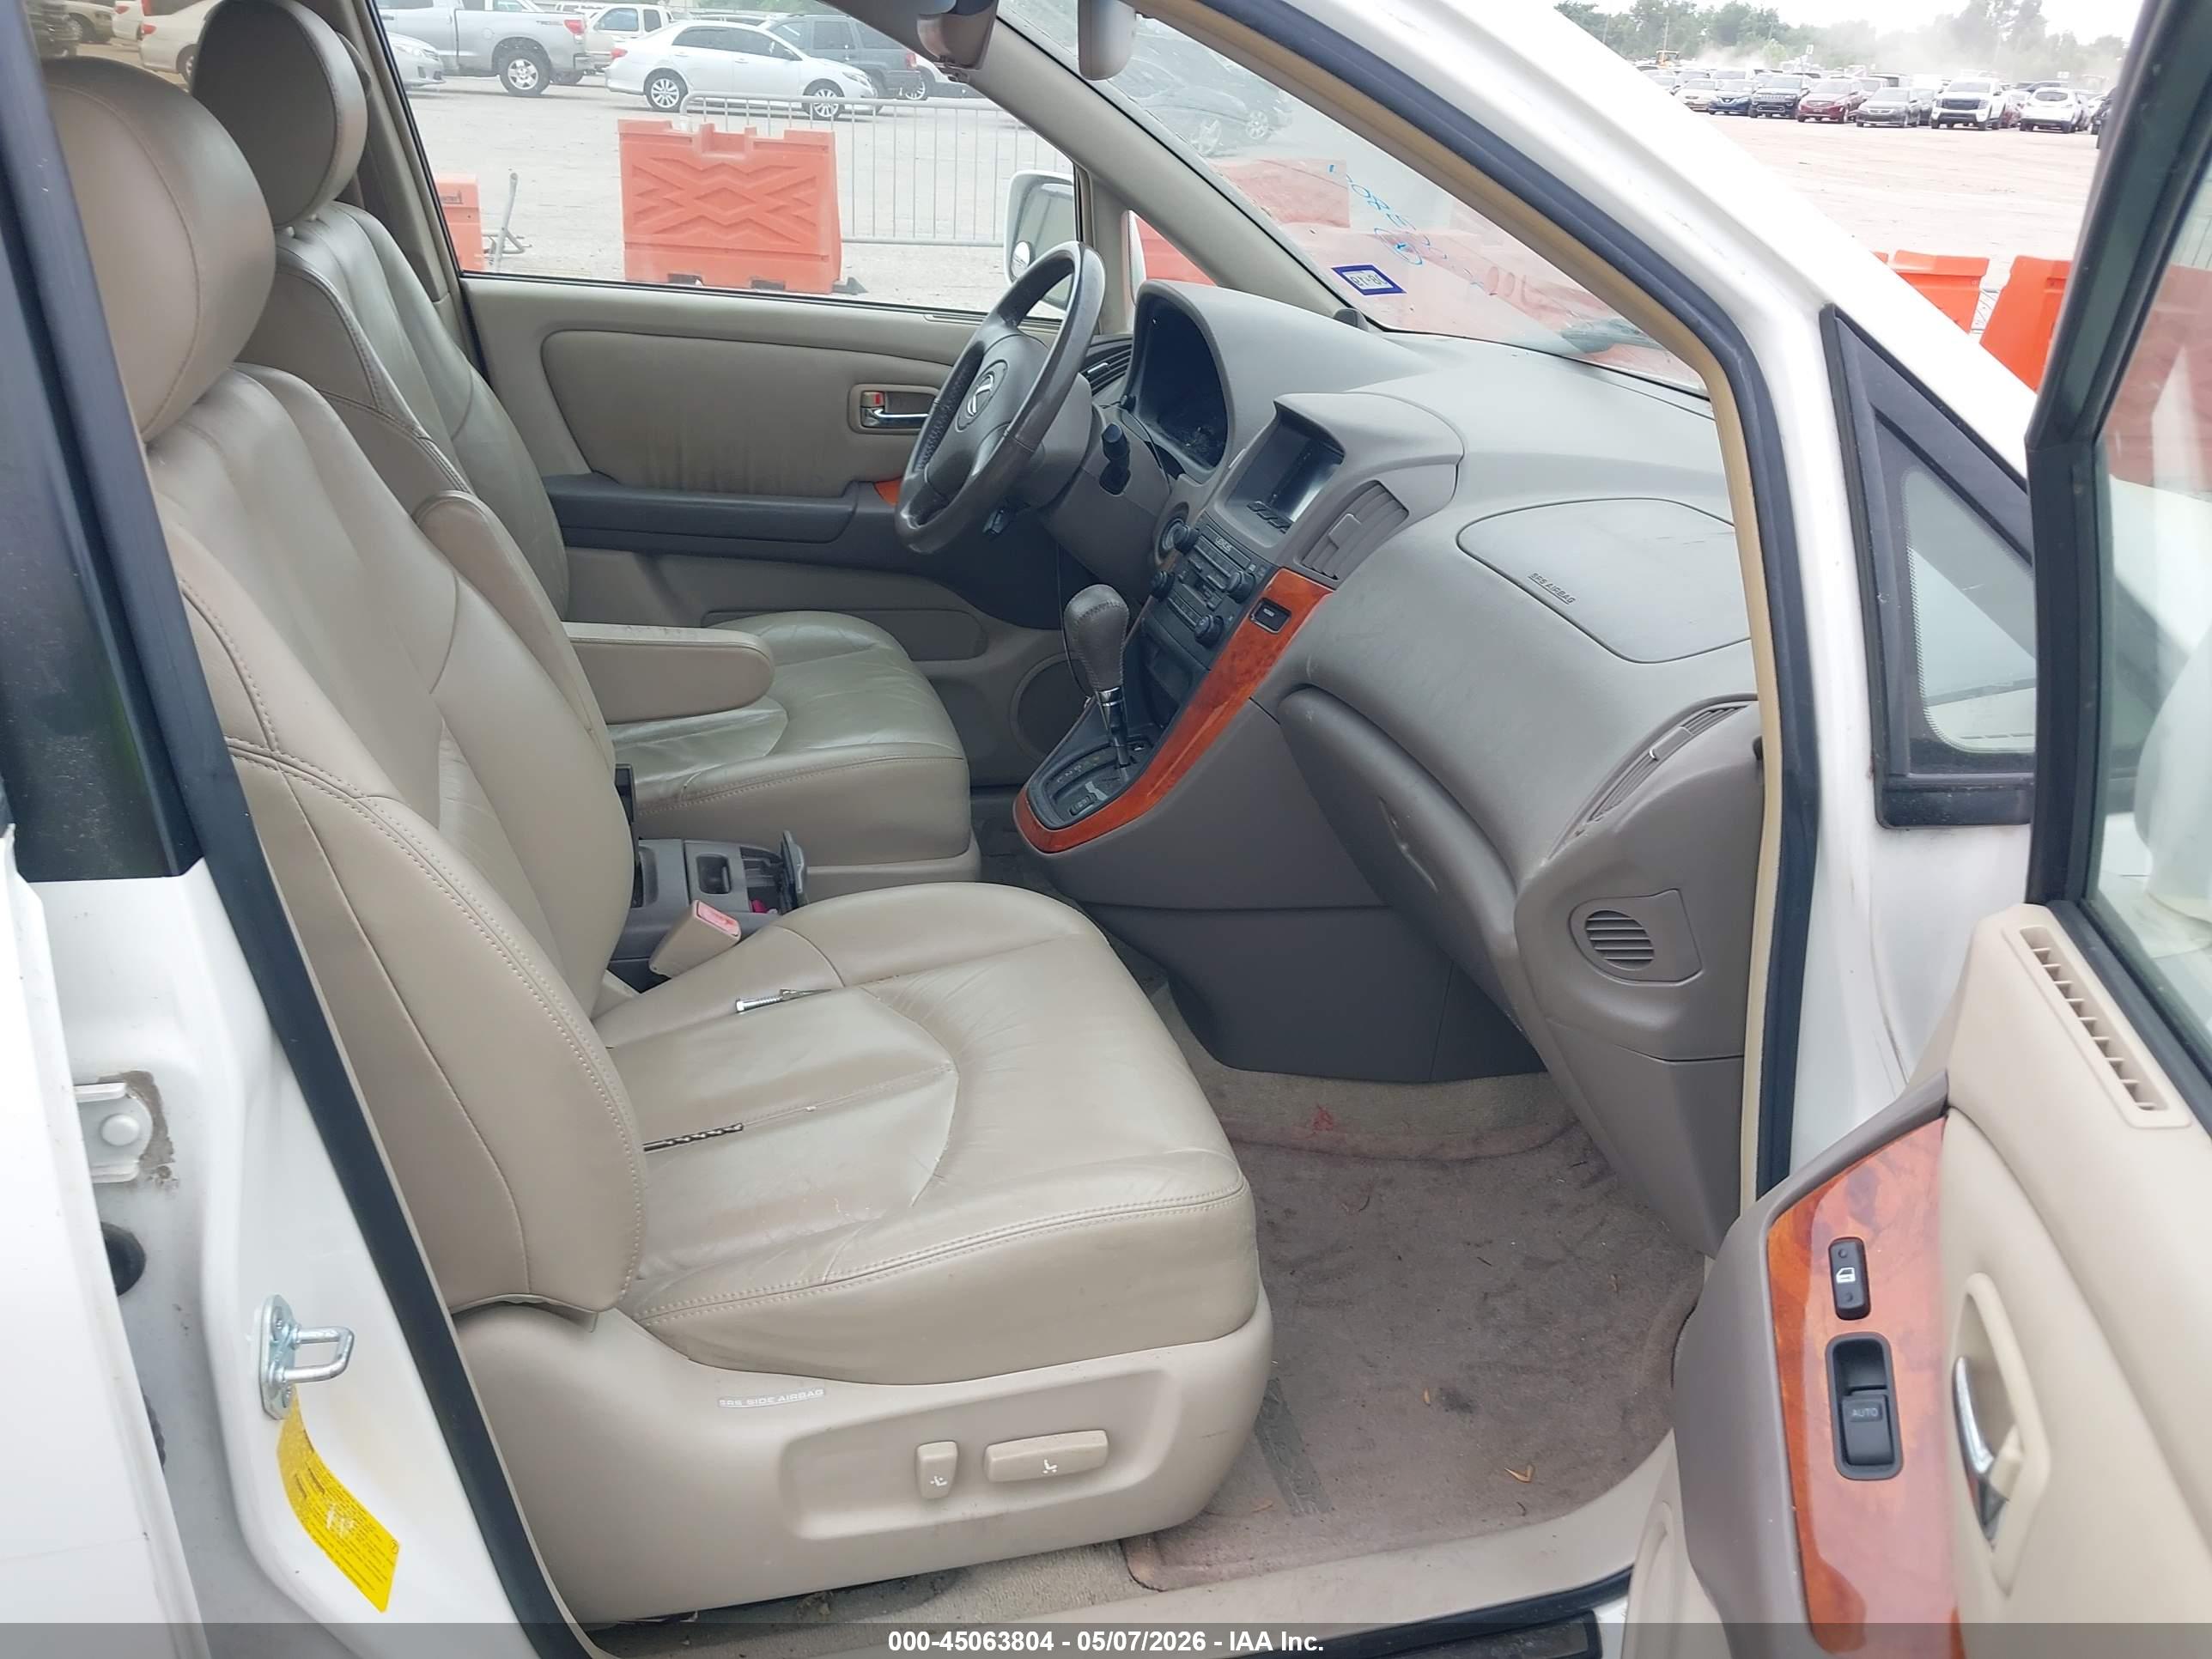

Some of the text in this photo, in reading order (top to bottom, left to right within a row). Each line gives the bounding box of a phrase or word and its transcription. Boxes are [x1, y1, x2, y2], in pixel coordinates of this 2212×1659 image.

[1546, 583, 1577, 604] AIRBAG
[746, 1397, 775, 1406] SIDE
[778, 1389, 825, 1403] AIRBAG
[1852, 1407, 1879, 1417] AUTO
